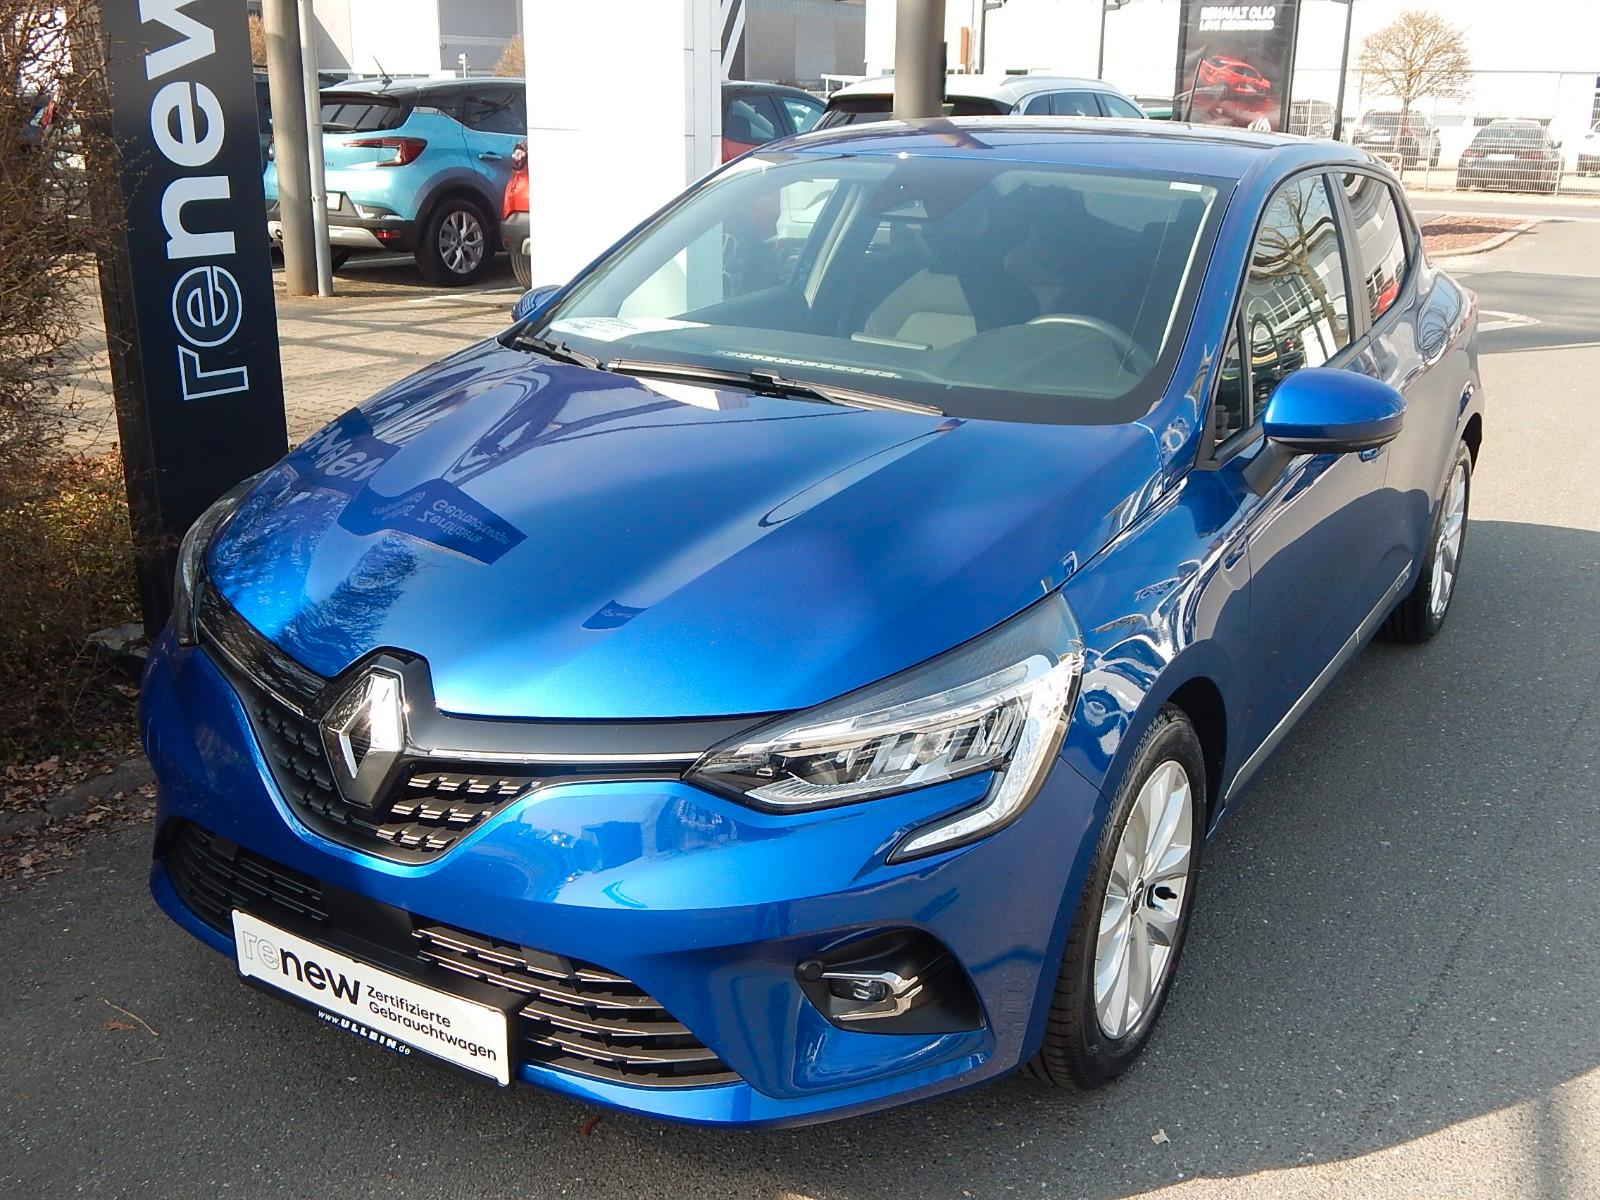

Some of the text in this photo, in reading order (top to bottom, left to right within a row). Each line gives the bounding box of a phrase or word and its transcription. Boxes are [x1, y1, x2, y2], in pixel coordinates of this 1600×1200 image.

[242, 930, 361, 1006] renew
[366, 984, 451, 1028] Zertifizierte
[369, 1001, 497, 1061] Gebrauchtwagen
